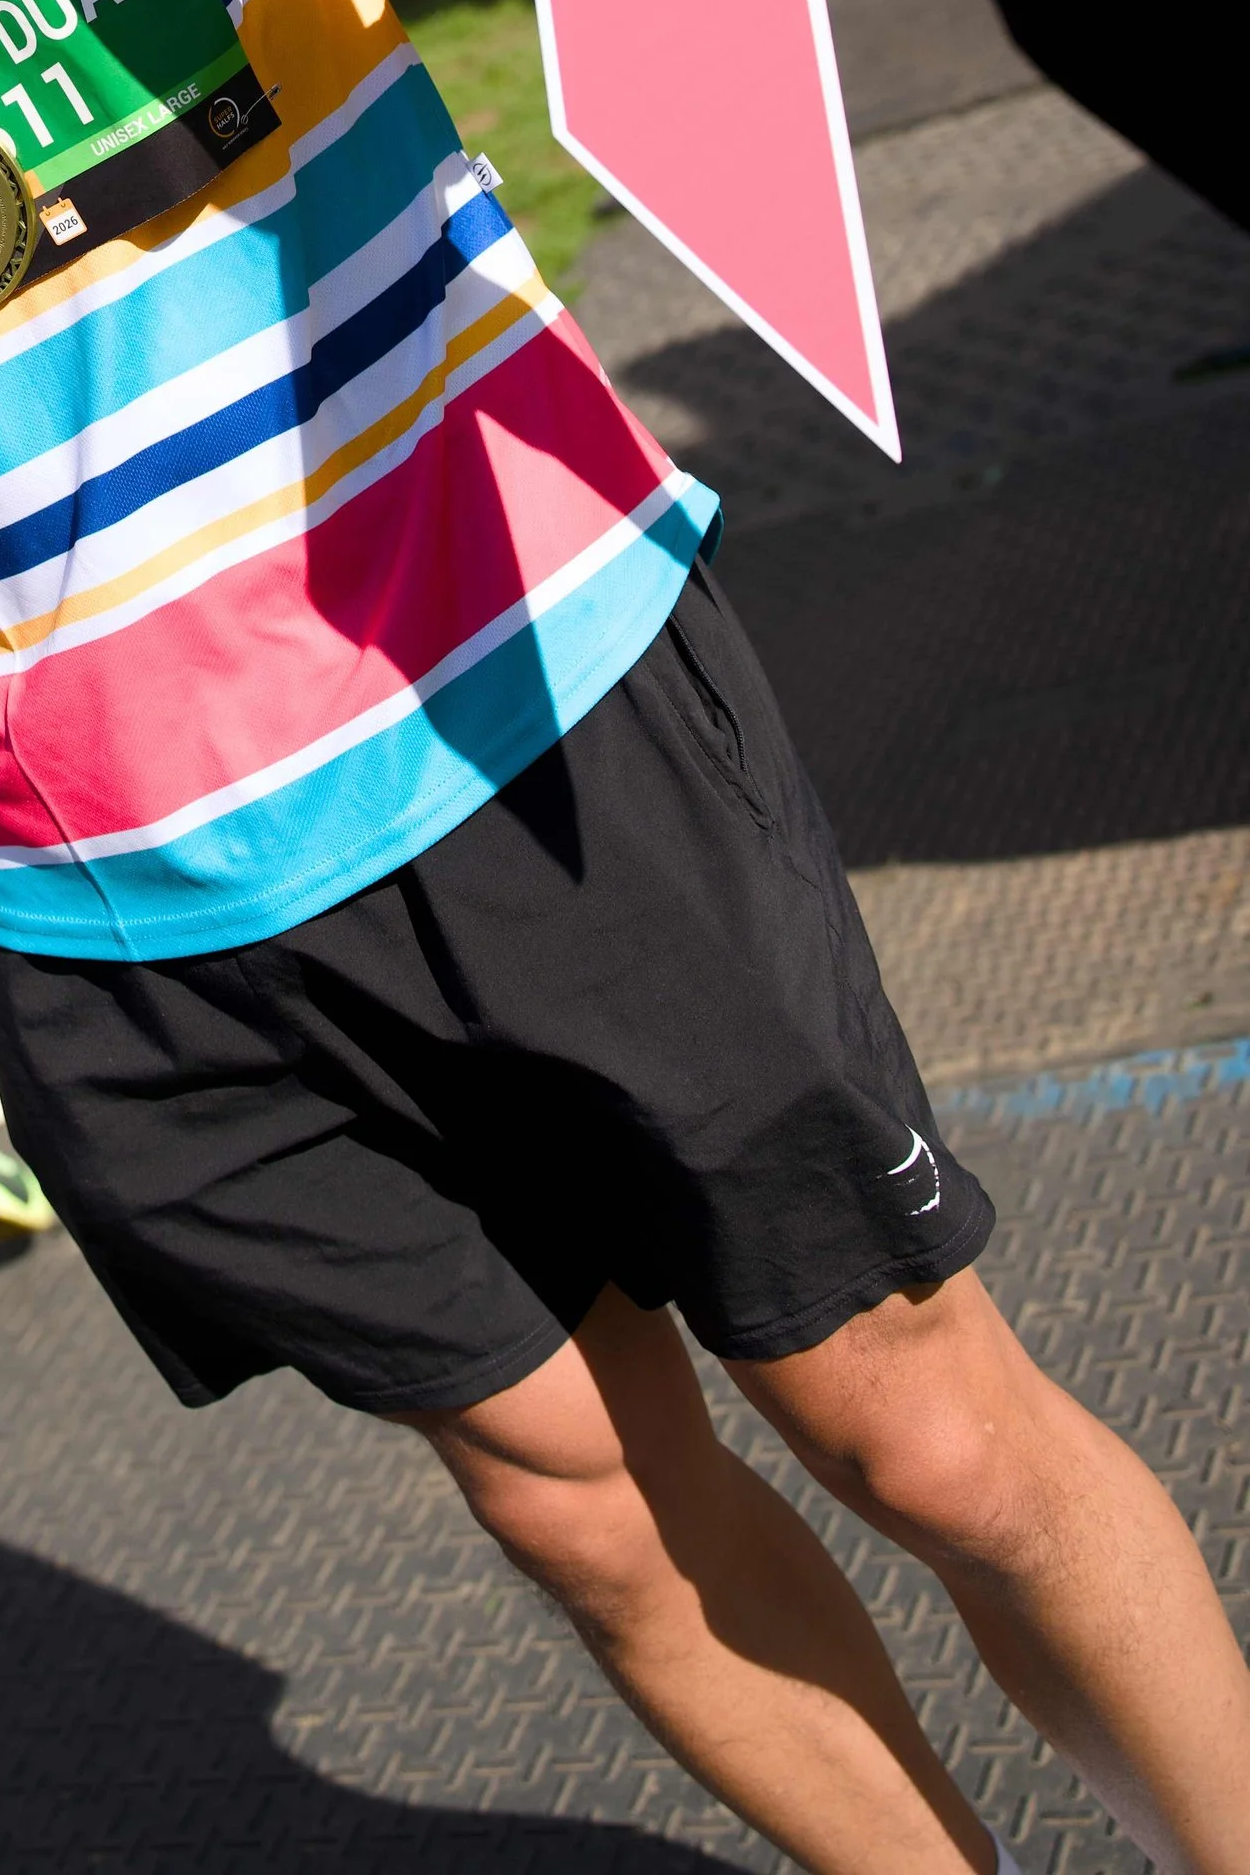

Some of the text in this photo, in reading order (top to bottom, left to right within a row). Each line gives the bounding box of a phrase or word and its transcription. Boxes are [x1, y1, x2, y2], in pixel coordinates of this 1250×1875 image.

[90, 82, 201, 157] UNISEX LARGE
[213, 106, 233, 124] SUPER
[216, 111, 235, 130] HALFS
[52, 215, 79, 236] 2026
